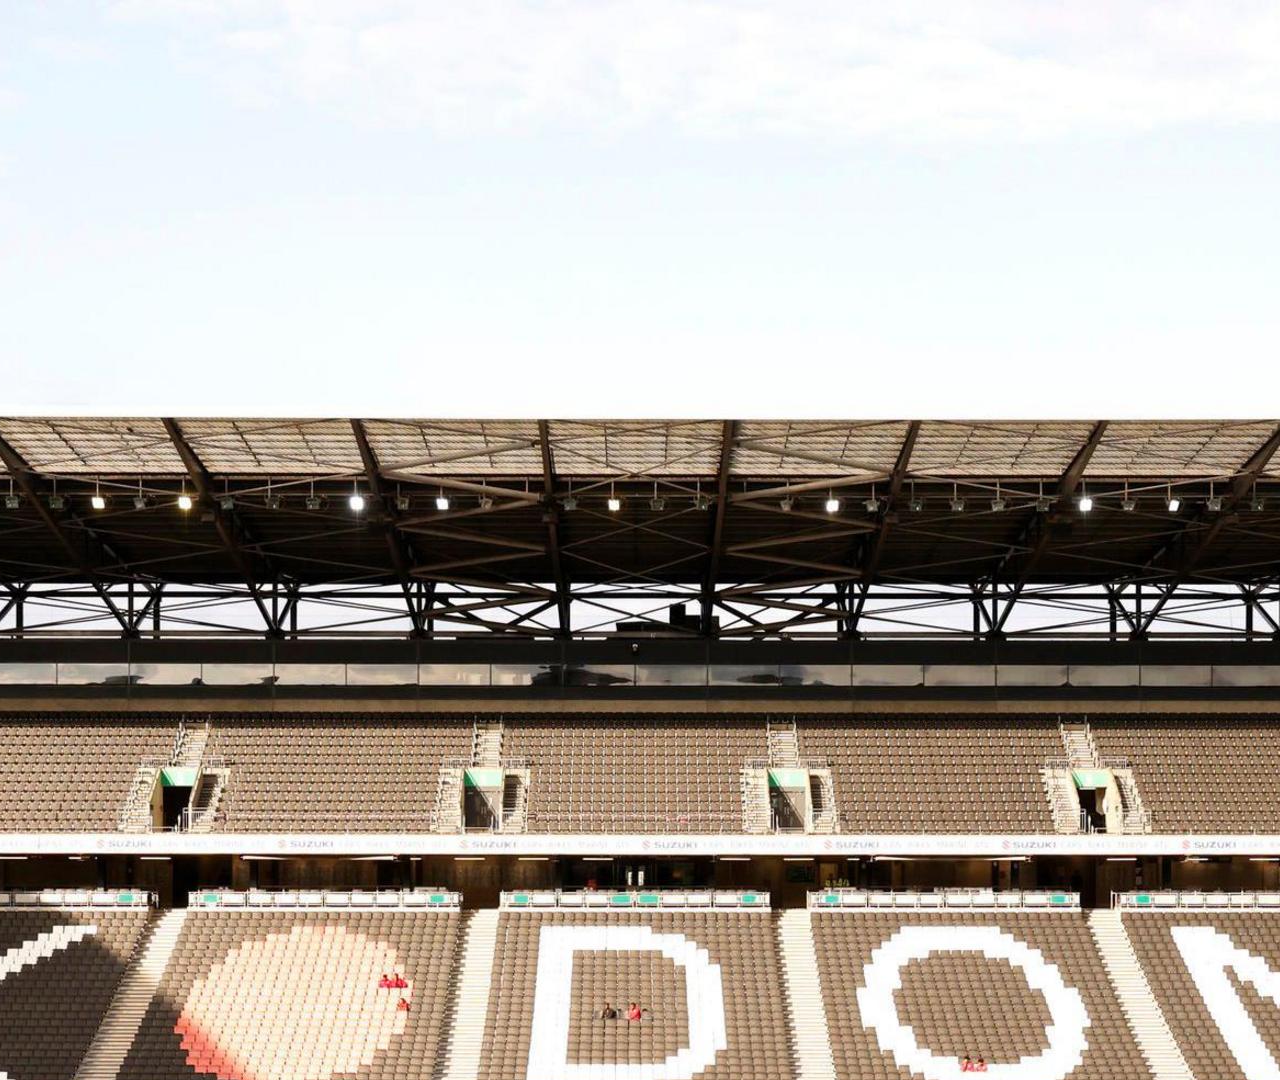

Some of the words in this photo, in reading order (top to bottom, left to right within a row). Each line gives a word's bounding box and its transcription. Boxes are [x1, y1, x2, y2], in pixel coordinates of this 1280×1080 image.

[108, 840, 152, 848] SUZUKI
[290, 840, 334, 848] SUZUKI
[472, 840, 517, 848] SUZUKI
